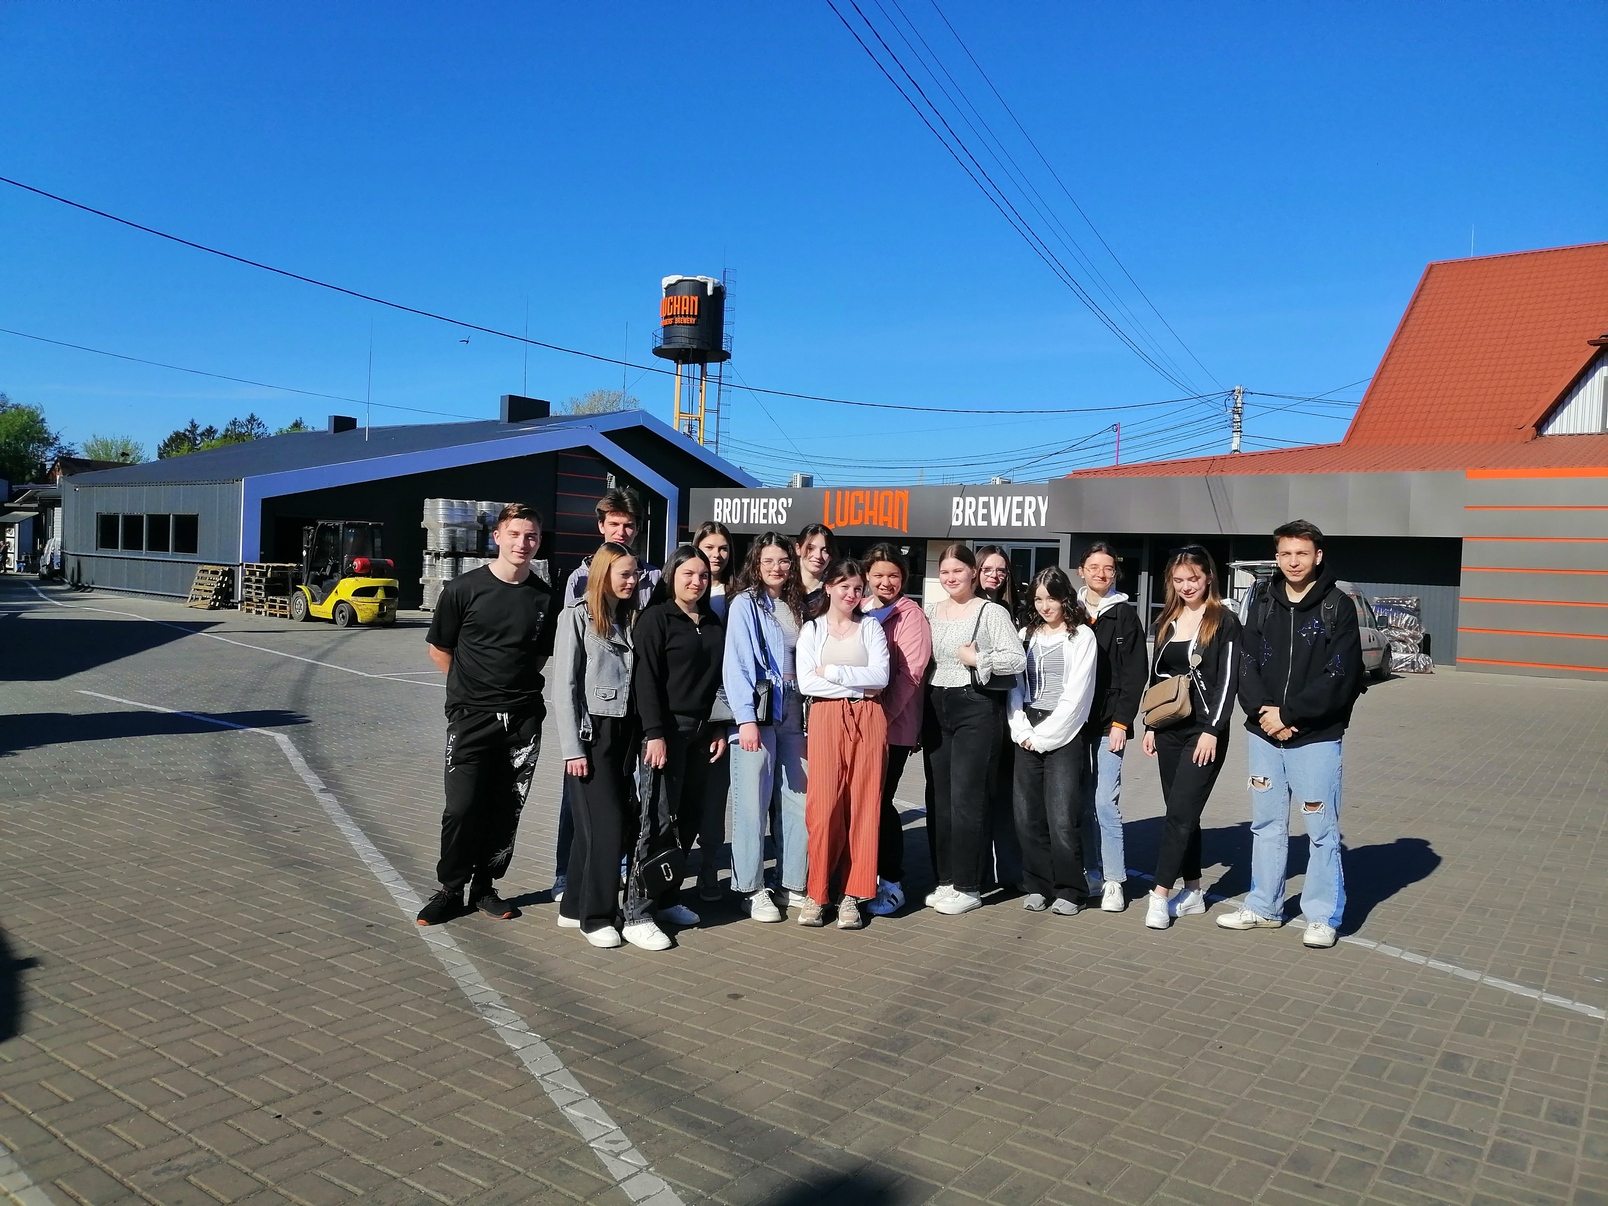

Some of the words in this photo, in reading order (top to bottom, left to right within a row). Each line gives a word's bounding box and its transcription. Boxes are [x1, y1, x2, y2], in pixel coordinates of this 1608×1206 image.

[713, 497, 793, 525] BROTHERS'
[823, 489, 909, 533] LUCHAN
[951, 495, 1049, 527] BREWERY
